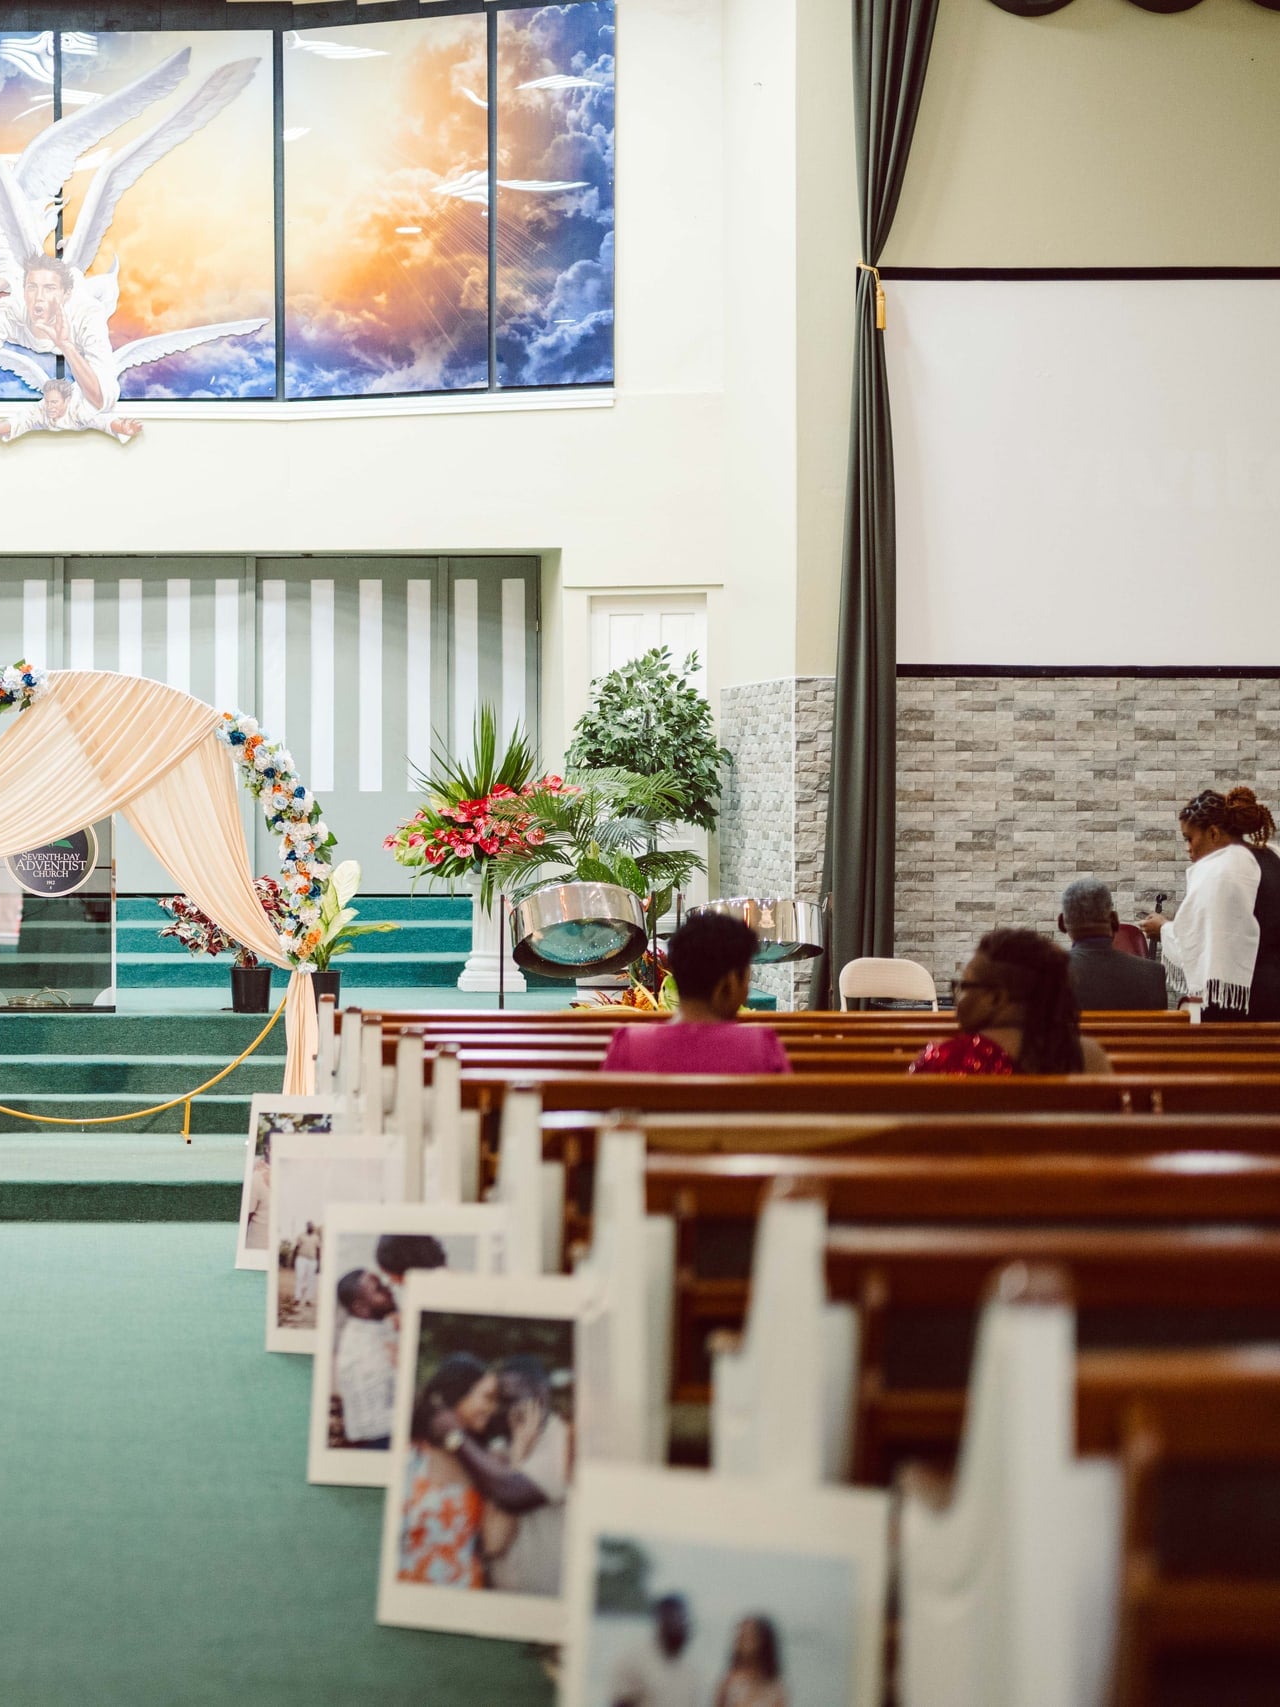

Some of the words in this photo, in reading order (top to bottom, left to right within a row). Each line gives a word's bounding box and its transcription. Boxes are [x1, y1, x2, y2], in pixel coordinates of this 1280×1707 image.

[22, 852, 80, 860] SEVENTH-DAY
[16, 860, 87, 871] ADVENTIST
[33, 870, 69, 878] CHURCH
